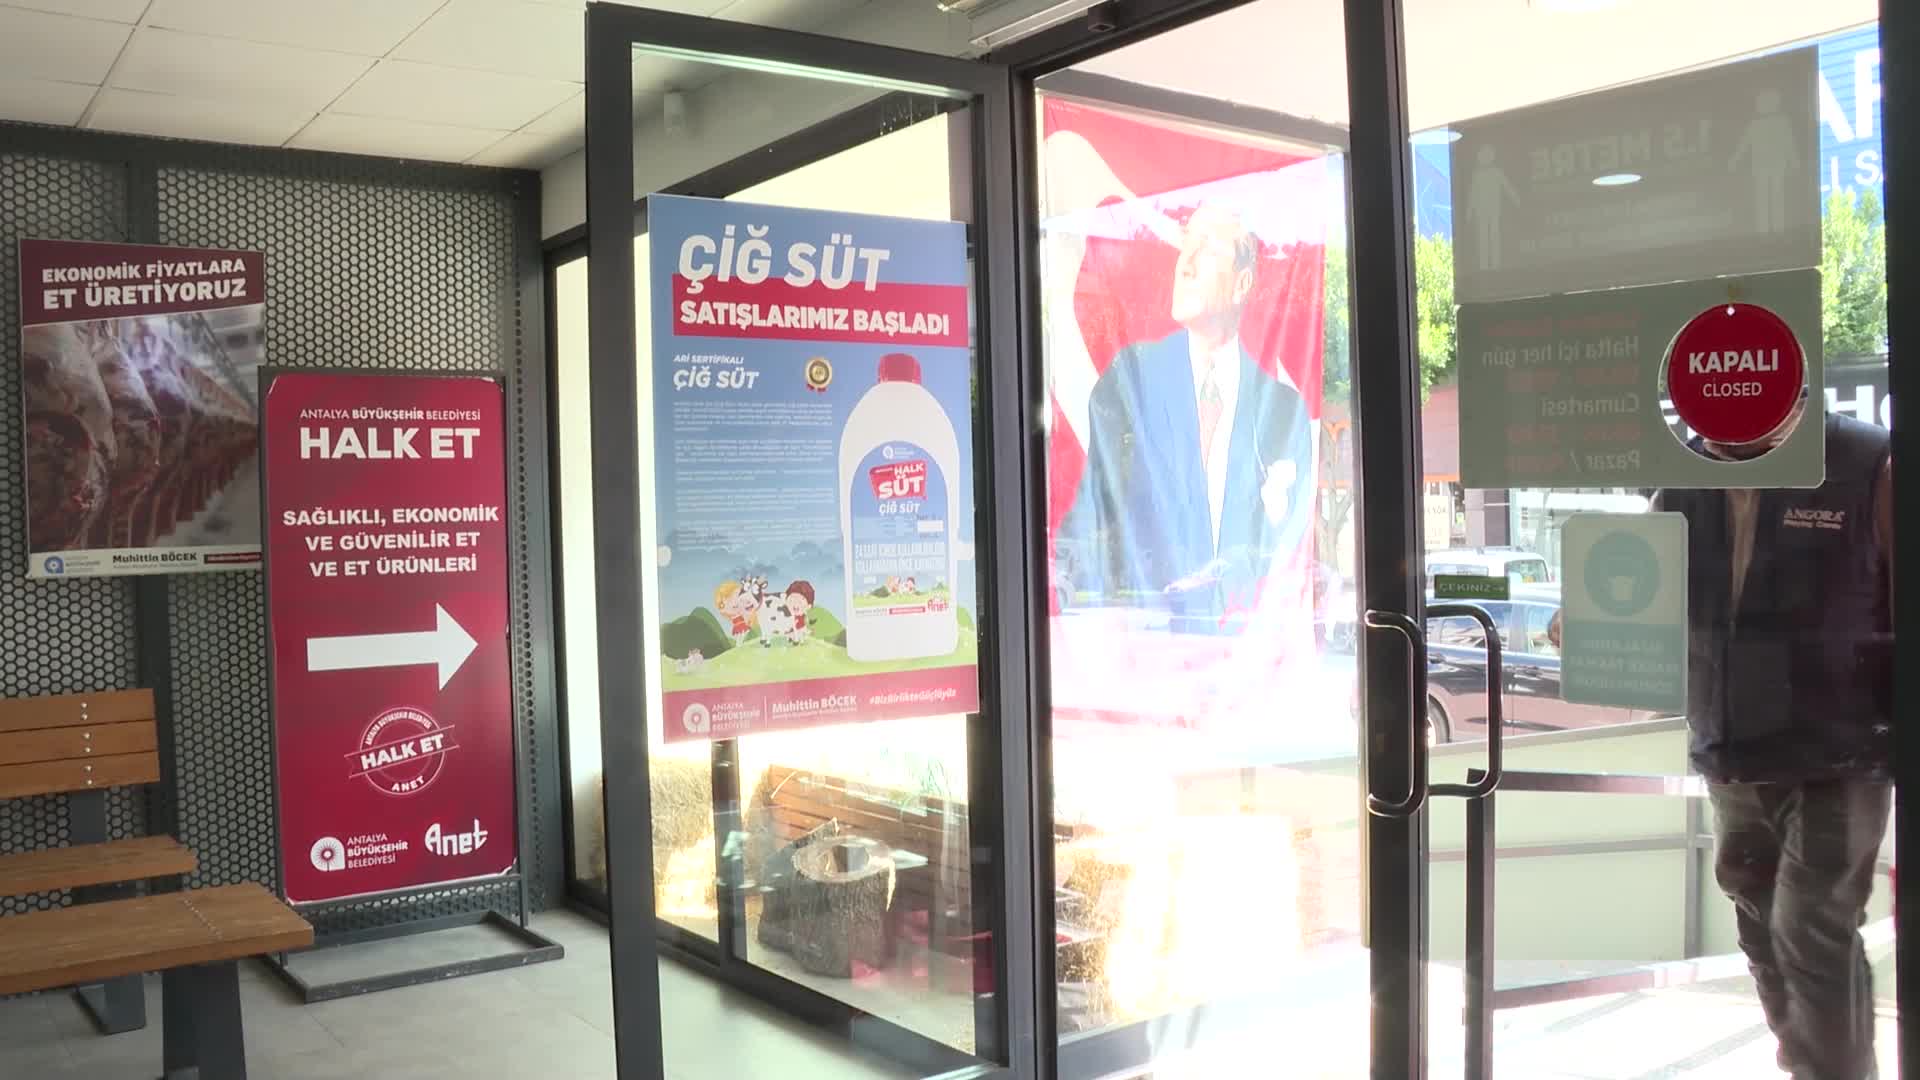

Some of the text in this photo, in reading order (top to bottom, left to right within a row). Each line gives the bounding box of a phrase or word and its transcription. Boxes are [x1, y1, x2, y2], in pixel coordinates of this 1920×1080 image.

[42, 257, 246, 283] EKONOMİK FİYATLARA
[677, 223, 890, 294] ÇİĞ SÜT
[43, 277, 247, 310] ET ÜRETİYORUZ
[680, 300, 950, 337] SATIŞLARIMIZ BAŞLADI
[1688, 348, 1779, 374] KAPALI
[672, 365, 760, 392] ÇİĞ SÜT
[1702, 382, 1763, 397] CLOSED
[300, 407, 481, 421] ANTALYA BÜYÜKŞEHİR BELEDİYESİ
[300, 427, 481, 459] HALK ET
[893, 463, 924, 475] HALK
[878, 475, 924, 500] SÜT
[283, 504, 499, 527] SAĞLIKLI, EKONOMİK
[305, 530, 481, 551] VE GÜVENİLİR ET
[113, 553, 159, 564] Muhittin
[161, 552, 197, 562] BÖCEK
[310, 553, 477, 577] VE ET ÜRÜNLERİ
[772, 694, 857, 713] Muhittin BÖCEK
[360, 733, 444, 770] HALK ET
[391, 775, 425, 792] ANET
[347, 833, 388, 845] ANTALYA
[347, 840, 409, 857] BÜYÜKŞEHİR
[425, 819, 488, 856] Anet
[348, 854, 396, 869] BELEDİYESİ
